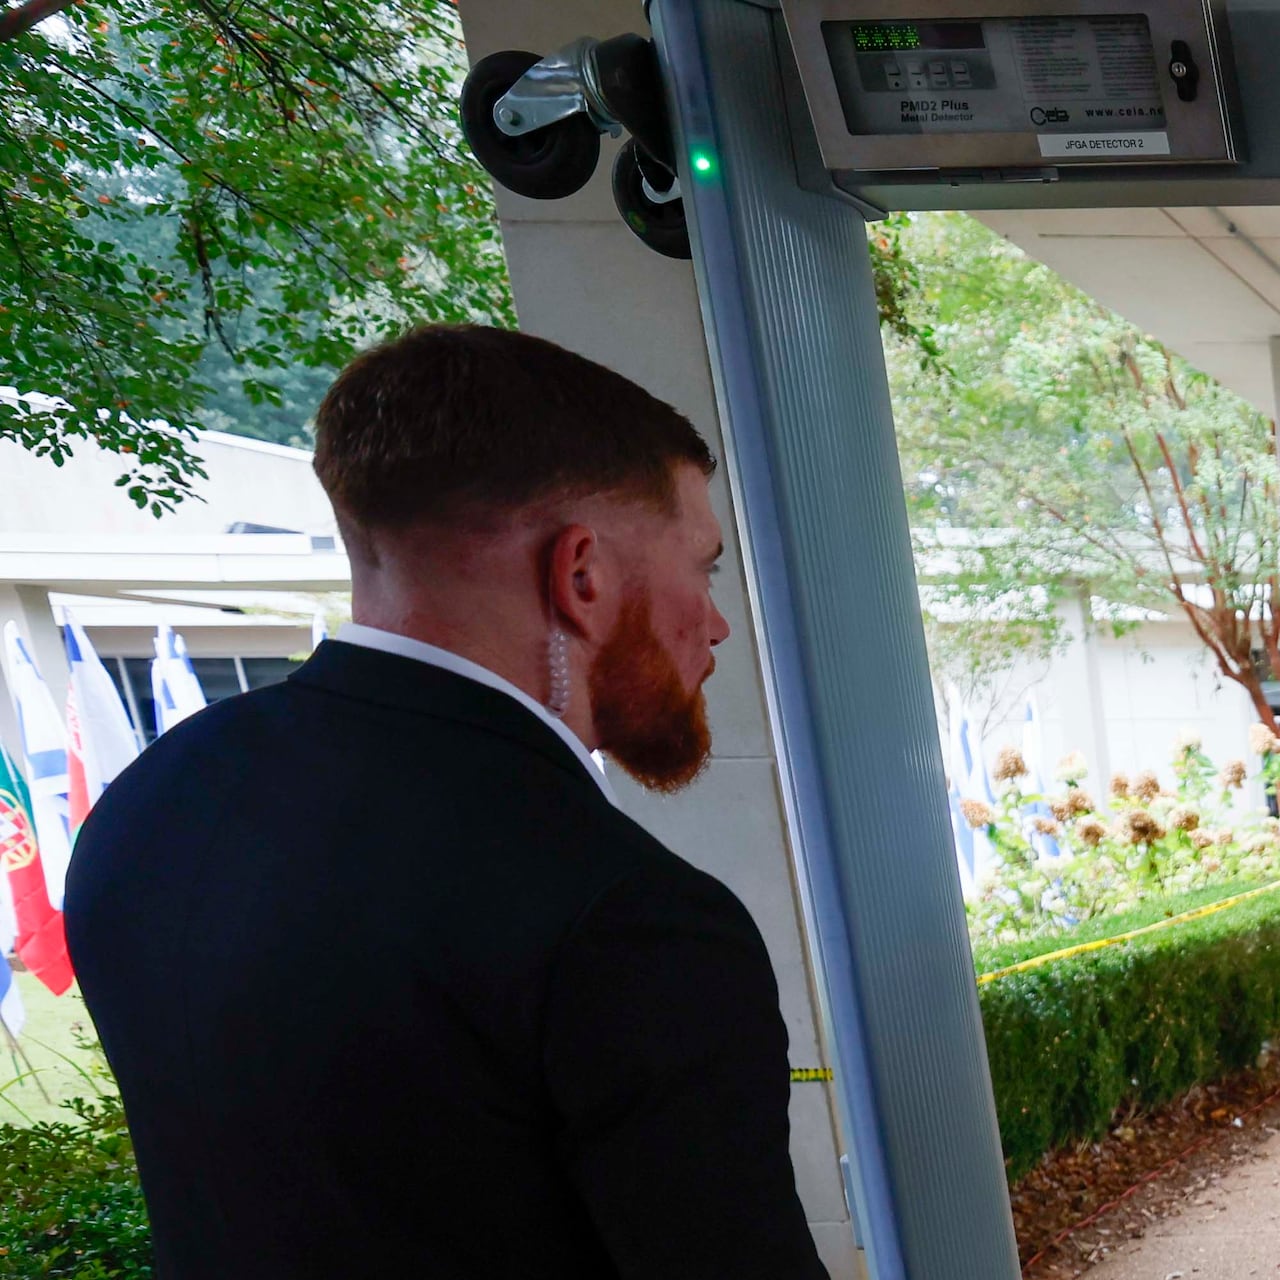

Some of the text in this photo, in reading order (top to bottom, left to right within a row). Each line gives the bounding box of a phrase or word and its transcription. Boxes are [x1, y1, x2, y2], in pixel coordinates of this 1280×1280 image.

[900, 99, 969, 112] PMD2 Plus
[1085, 106, 1164, 117] www.ceia.ne
[901, 112, 974, 123] Metal Detector
[1065, 138, 1144, 150] JFGA DETECTOR 2
